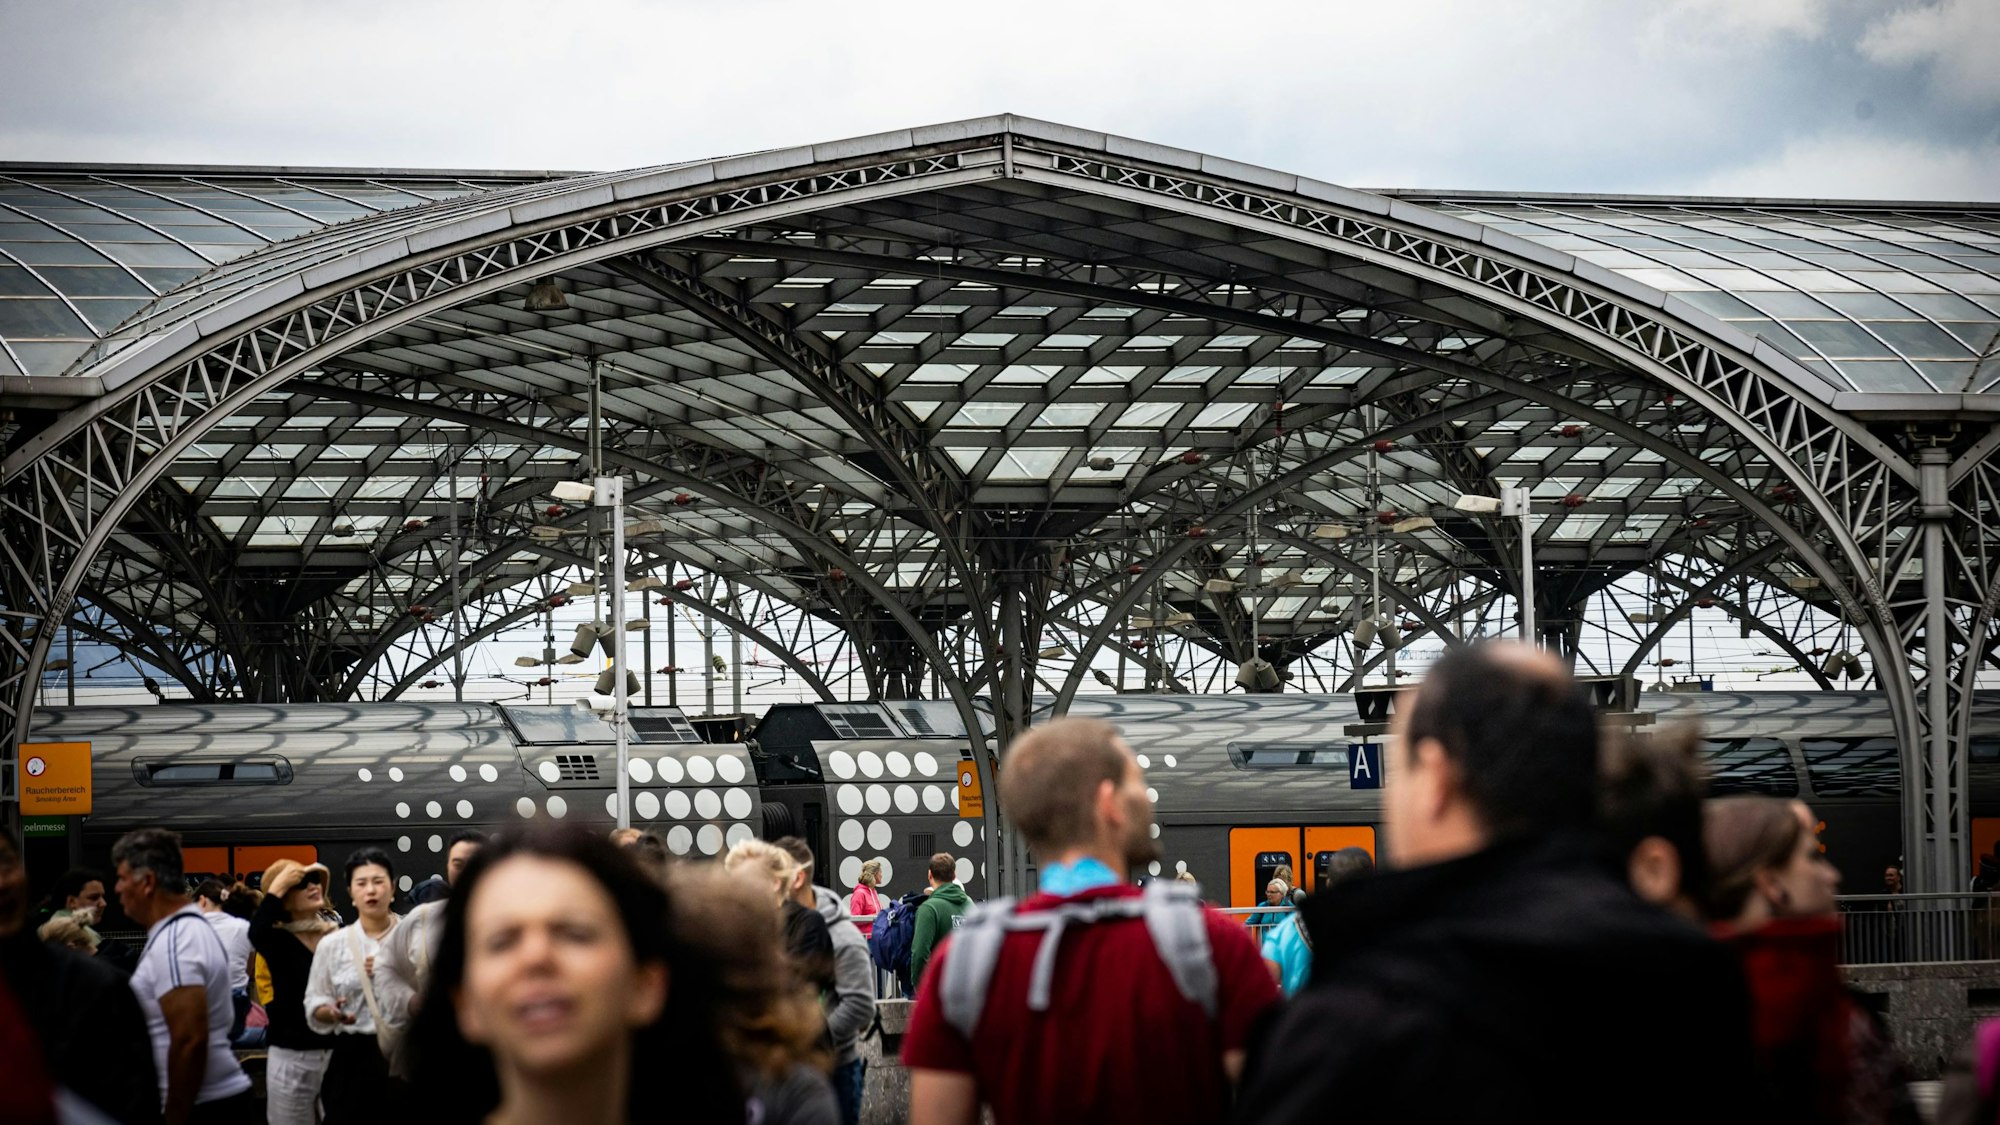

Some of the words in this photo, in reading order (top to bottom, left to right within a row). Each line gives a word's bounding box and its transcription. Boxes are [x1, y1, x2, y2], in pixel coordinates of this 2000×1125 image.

[1353, 745, 1372, 779] A
[25, 786, 86, 794] Raucherbereich
[24, 822, 66, 832] oelnmesse
